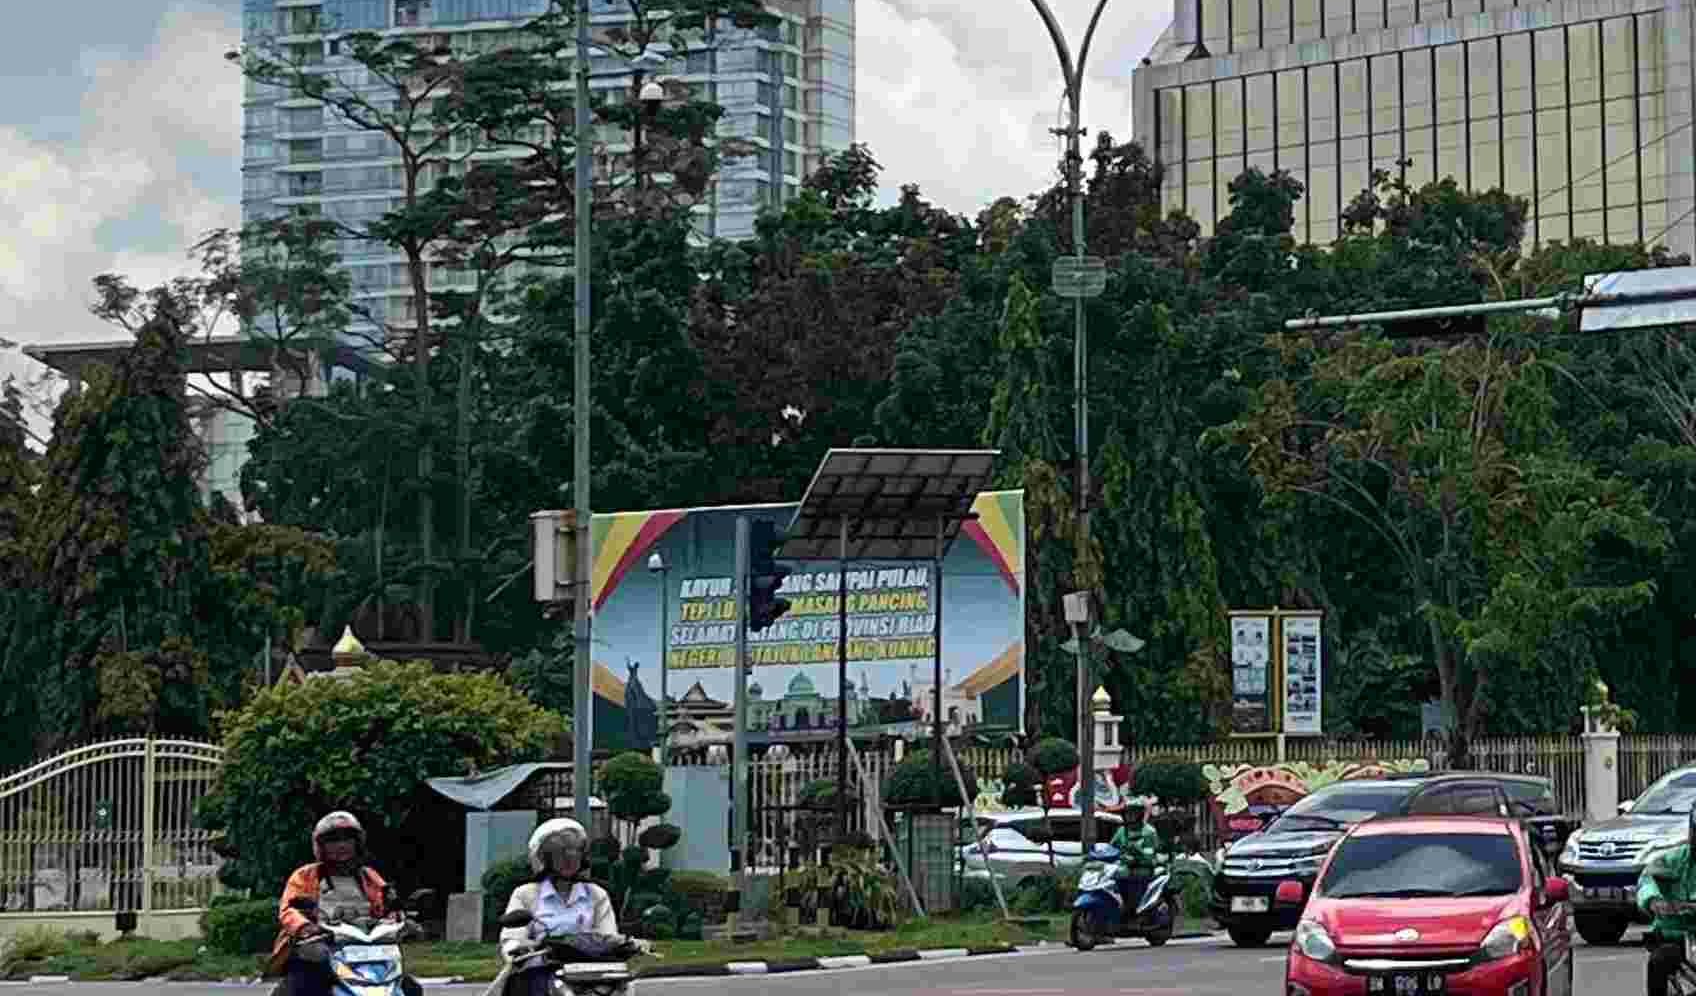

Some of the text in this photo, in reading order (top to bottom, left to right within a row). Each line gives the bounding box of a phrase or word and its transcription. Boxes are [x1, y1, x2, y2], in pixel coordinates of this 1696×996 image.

[671, 624, 737, 646] SELAMAT
[744, 618, 800, 642] ATANG
[801, 619, 818, 639] DI
[897, 614, 936, 634] RIAU
